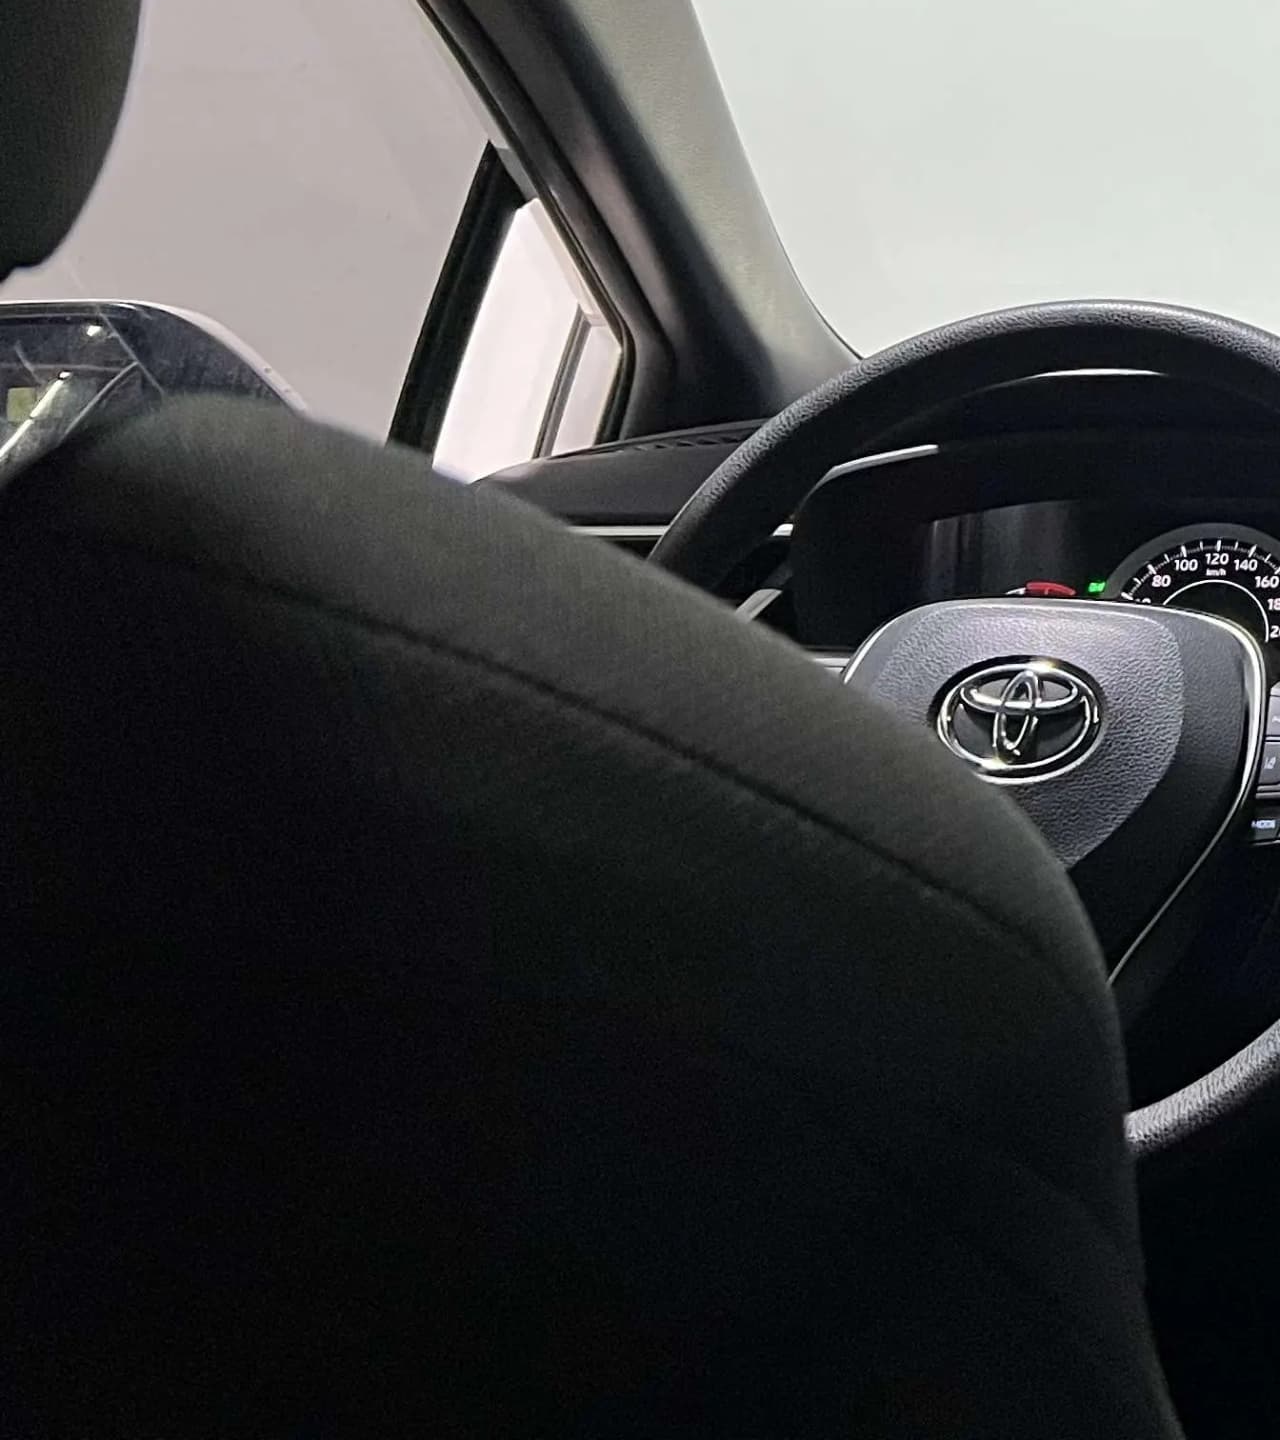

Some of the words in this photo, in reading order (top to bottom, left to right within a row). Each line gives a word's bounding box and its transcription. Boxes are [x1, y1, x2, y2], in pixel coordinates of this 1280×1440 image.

[1205, 552, 1229, 565] 120
[1174, 559, 1199, 572] 100
[1234, 559, 1258, 572] 140
[1206, 568, 1227, 577] km/h
[1151, 574, 1171, 588] 80
[1255, 576, 1280, 589] 160
